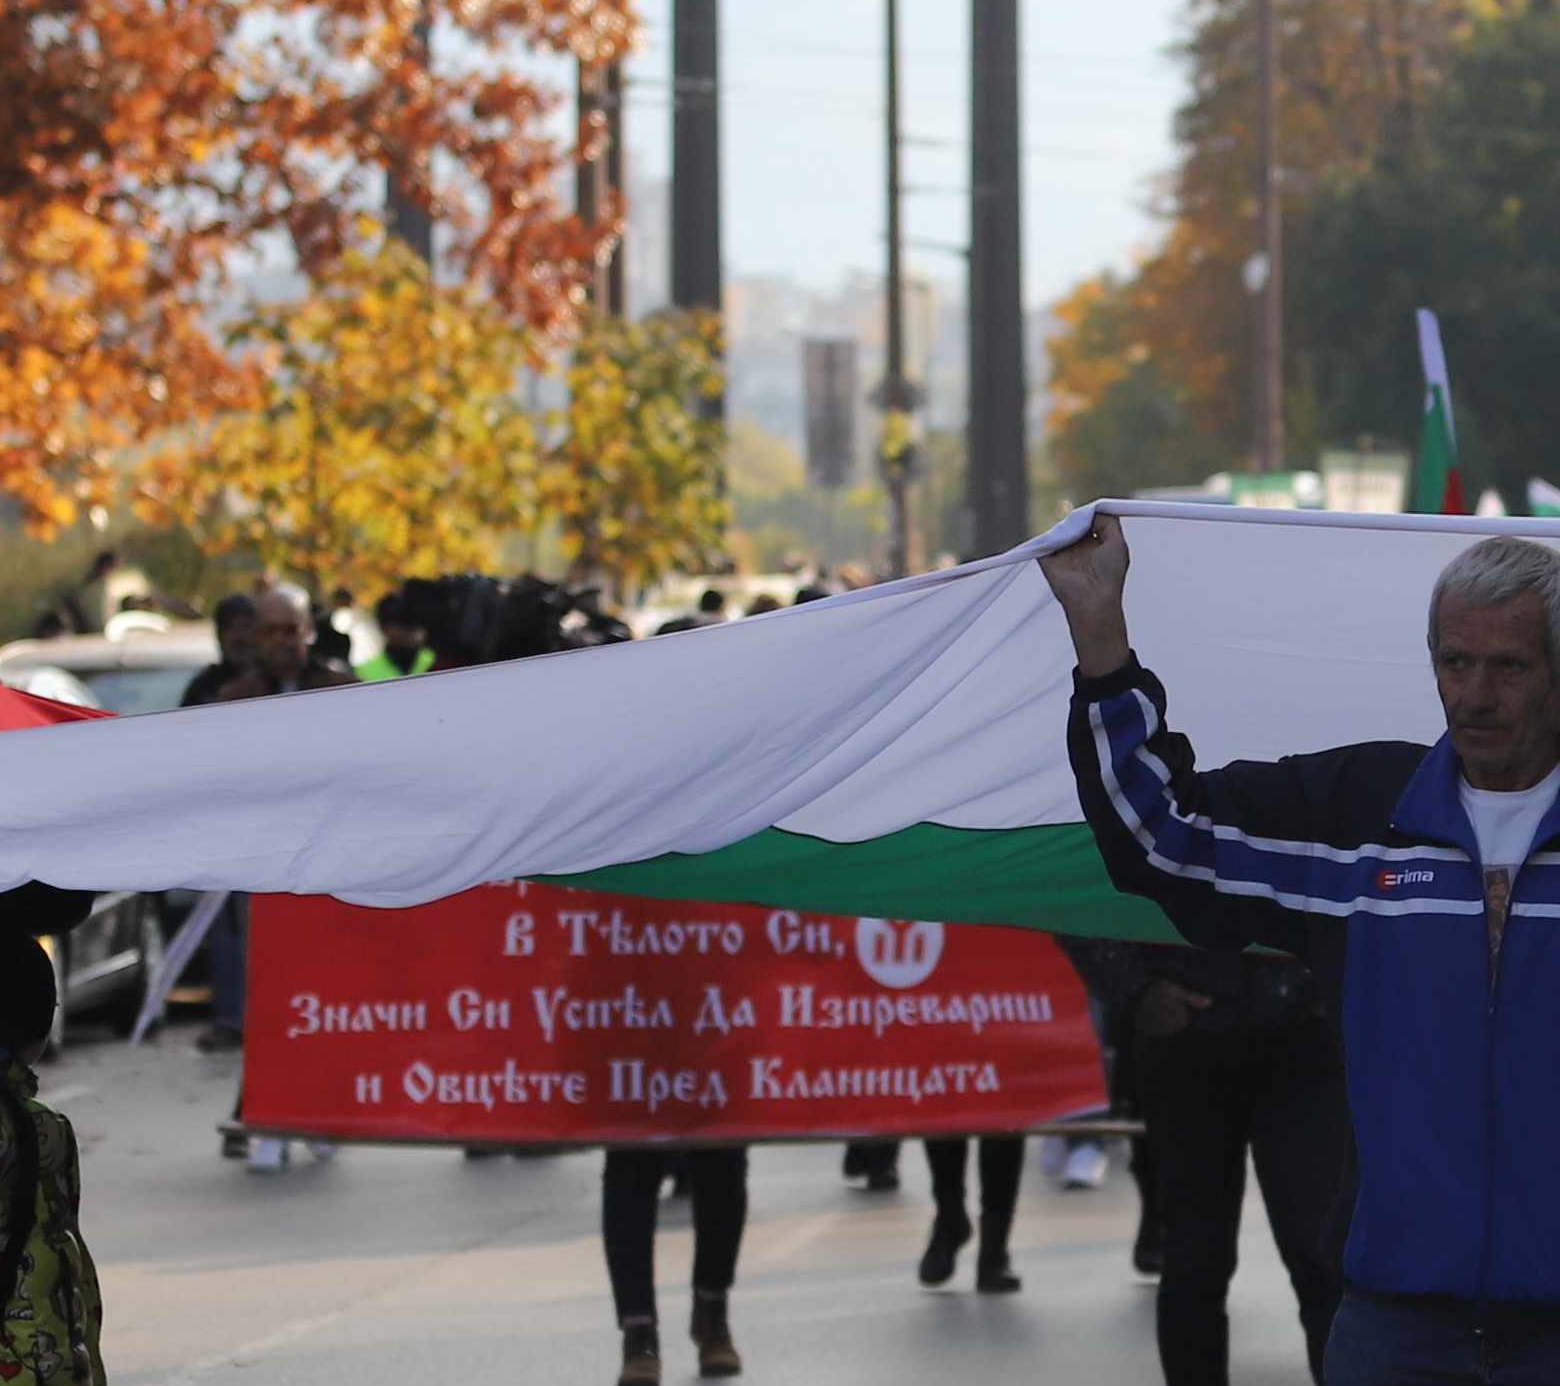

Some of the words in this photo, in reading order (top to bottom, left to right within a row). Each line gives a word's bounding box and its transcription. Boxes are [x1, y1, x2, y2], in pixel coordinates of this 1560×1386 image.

[287, 993, 427, 1039] Значи
[447, 988, 510, 1031] Си
[693, 985, 757, 1035] Да
[778, 984, 1053, 1037] Изпревариш
[355, 1074, 382, 1104] и
[609, 1059, 728, 1113] Пред
[750, 1056, 1000, 1104] Кланицата
